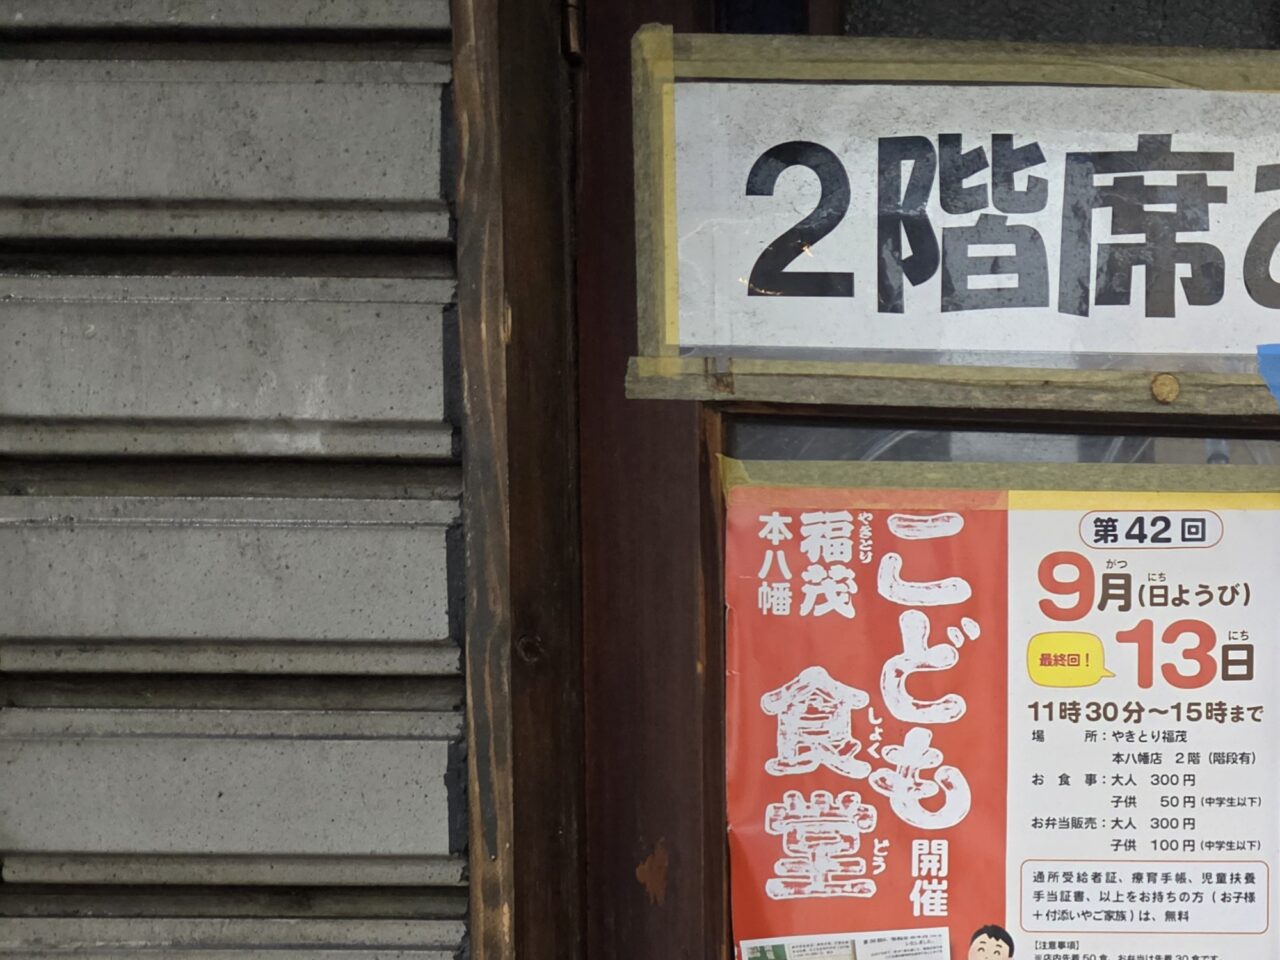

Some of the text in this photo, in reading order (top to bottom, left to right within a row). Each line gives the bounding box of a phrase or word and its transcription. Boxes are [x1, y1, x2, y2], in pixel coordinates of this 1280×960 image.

[857, 511, 874, 564] やきとり
[1093, 516, 1206, 544] 第42回
[758, 511, 793, 615] 本八幡
[800, 510, 858, 619] 福茂
[1105, 559, 1128, 569] がつ
[1147, 572, 1167, 582] にち
[1037, 551, 1132, 622] 9月
[1228, 631, 1249, 641] にち
[1039, 653, 1090, 667] 最終回！
[1115, 619, 1255, 690] 13日
[868, 512, 981, 830] こども
[866, 707, 884, 759] しょく
[1112, 752, 1162, 765] 本八幡店
[760, 665, 878, 900] 食堂
[1150, 773, 1196, 787] 300円
[1110, 796, 1137, 809] 子供
[1150, 817, 1196, 830] 300円
[872, 838, 890, 875] どう
[1110, 839, 1137, 852] 子供
[1151, 839, 1196, 852] 100円
[909, 839, 949, 917] 開催
